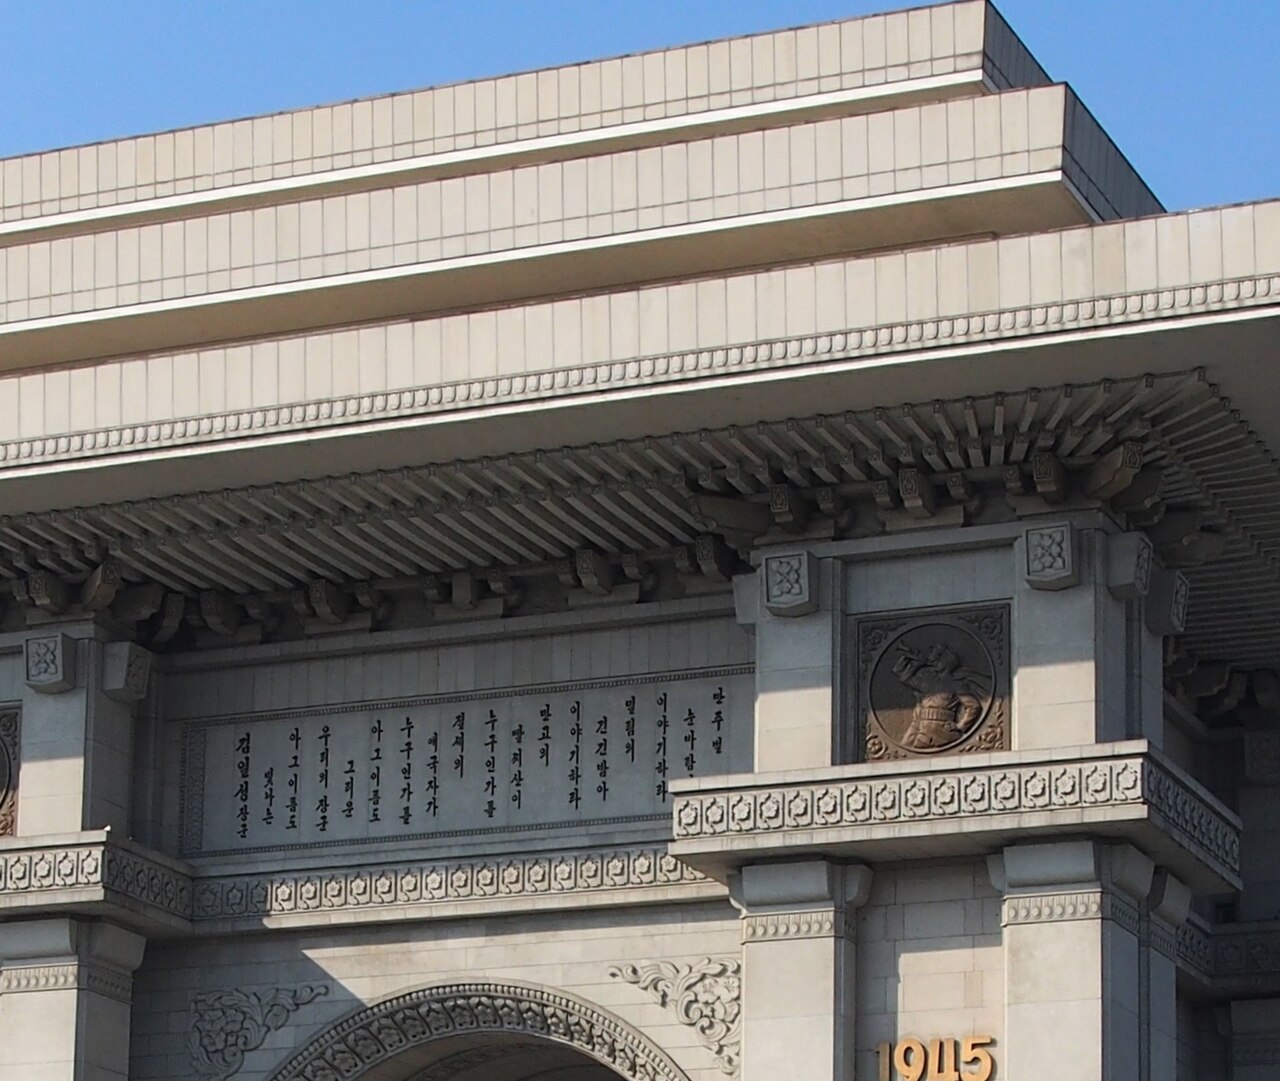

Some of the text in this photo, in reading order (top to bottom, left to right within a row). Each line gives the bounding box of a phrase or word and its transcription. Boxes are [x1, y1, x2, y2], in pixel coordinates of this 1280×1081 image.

[538, 703, 552, 768] 만고의
[568, 701, 583, 810] 이야기하라
[625, 695, 636, 763] 밀림의
[655, 692, 669, 803] 이야기하라
[683, 708, 697, 778] 눈바람
[712, 687, 725, 754] 만주벌
[341, 760, 356, 818] 그리운
[399, 717, 414, 824] 누구인가를
[426, 731, 439, 817] 애국자가
[484, 709, 498, 818] 누구인가를
